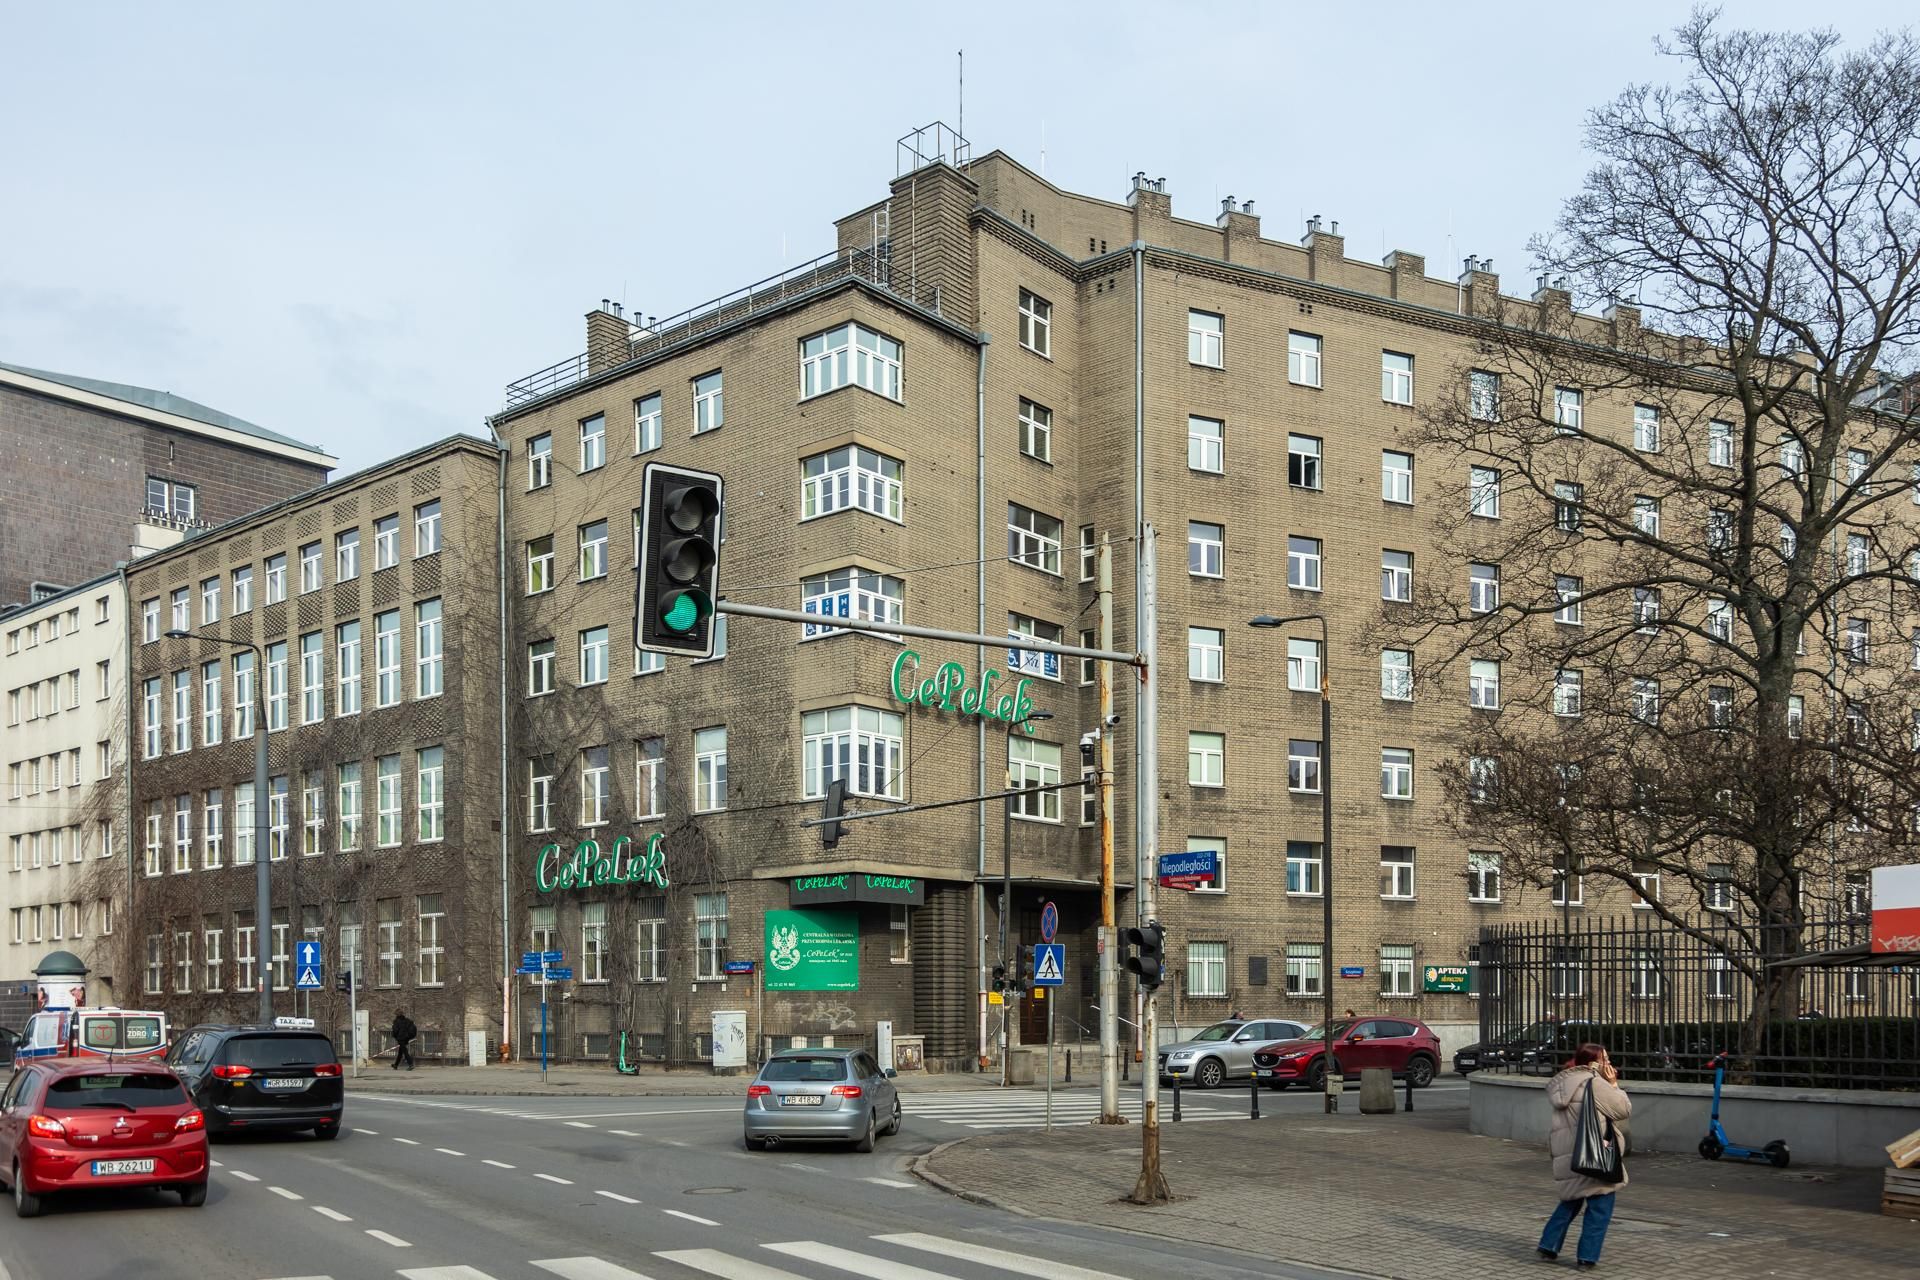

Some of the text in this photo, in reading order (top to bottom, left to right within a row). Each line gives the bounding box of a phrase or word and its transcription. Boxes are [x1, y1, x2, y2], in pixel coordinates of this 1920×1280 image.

[891, 650, 1035, 735] CePeLek
[535, 832, 670, 893] CePeLek
[1161, 859, 1211, 876] Niepodległości
[1438, 967, 1468, 975] APTEKA
[786, 1095, 797, 1104] WB
[100, 1160, 152, 1172] WB 2621U
